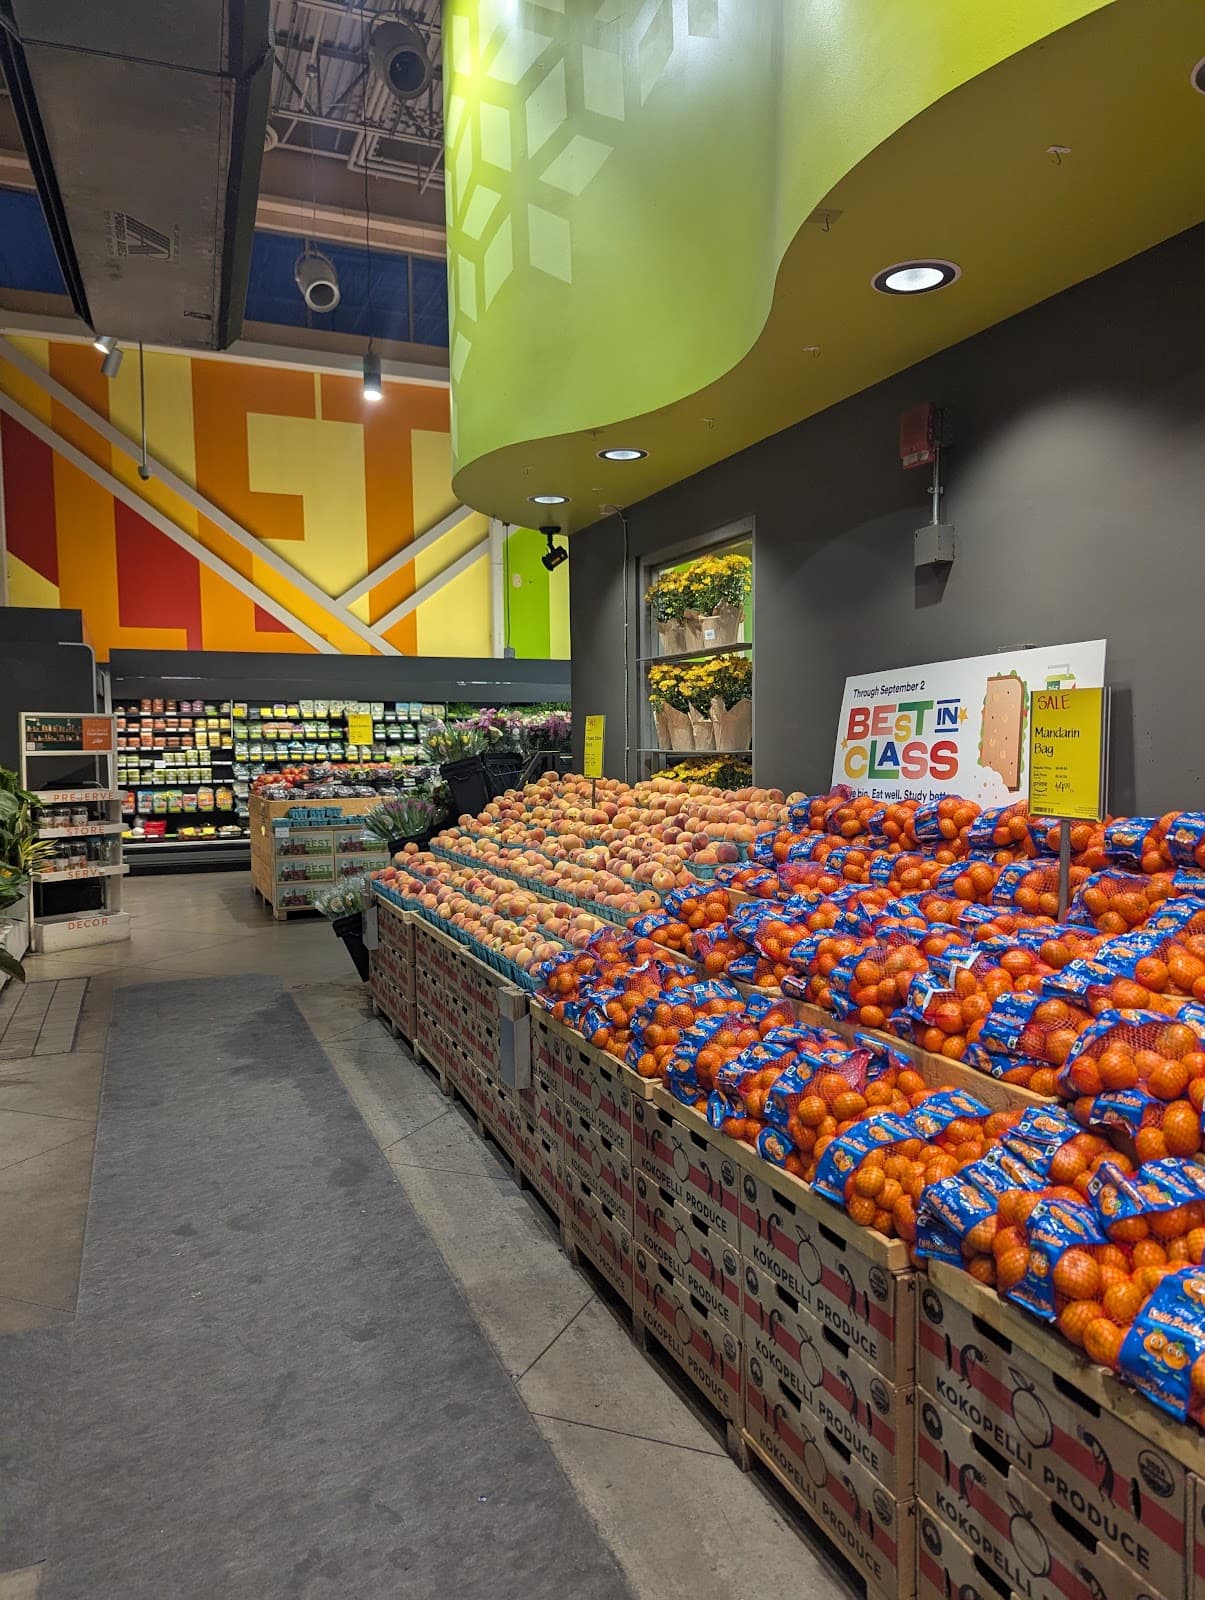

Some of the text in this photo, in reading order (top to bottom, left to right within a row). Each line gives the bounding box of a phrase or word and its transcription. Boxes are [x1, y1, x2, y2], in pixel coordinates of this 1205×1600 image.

[853, 680, 926, 699] Through September 2
[1037, 694, 1071, 711] SALE
[847, 700, 959, 742] BEST IN
[1034, 727, 1080, 739] Mandarin
[844, 740, 959, 781] CLASS
[1033, 743, 1054, 757] Bag
[871, 788, 883, 799] Eat
[884, 790, 902, 800] well.
[904, 789, 928, 803] Study
[66, 826, 105, 835] STORE
[304, 839, 330, 849] BEST
[304, 863, 331, 873] BEST
[67, 917, 109, 930] DECOR
[641, 1156, 727, 1233] KOKOPELLI PRODUCE
[643, 1233, 729, 1322] KOKOPELLI PRODUCE
[752, 1244, 877, 1361] KOKOPELLI PRODUCE
[643, 1306, 729, 1409] KOKOPELLI PRODUCE
[755, 1336, 880, 1472] KOKOPELLI PRODUCE
[935, 1375, 1151, 1572] KOKOPELLI PRODUCE
[759, 1427, 882, 1581] KOKOPELLI PRODUCE
[935, 1490, 1032, 1598] KOKOPELLI
